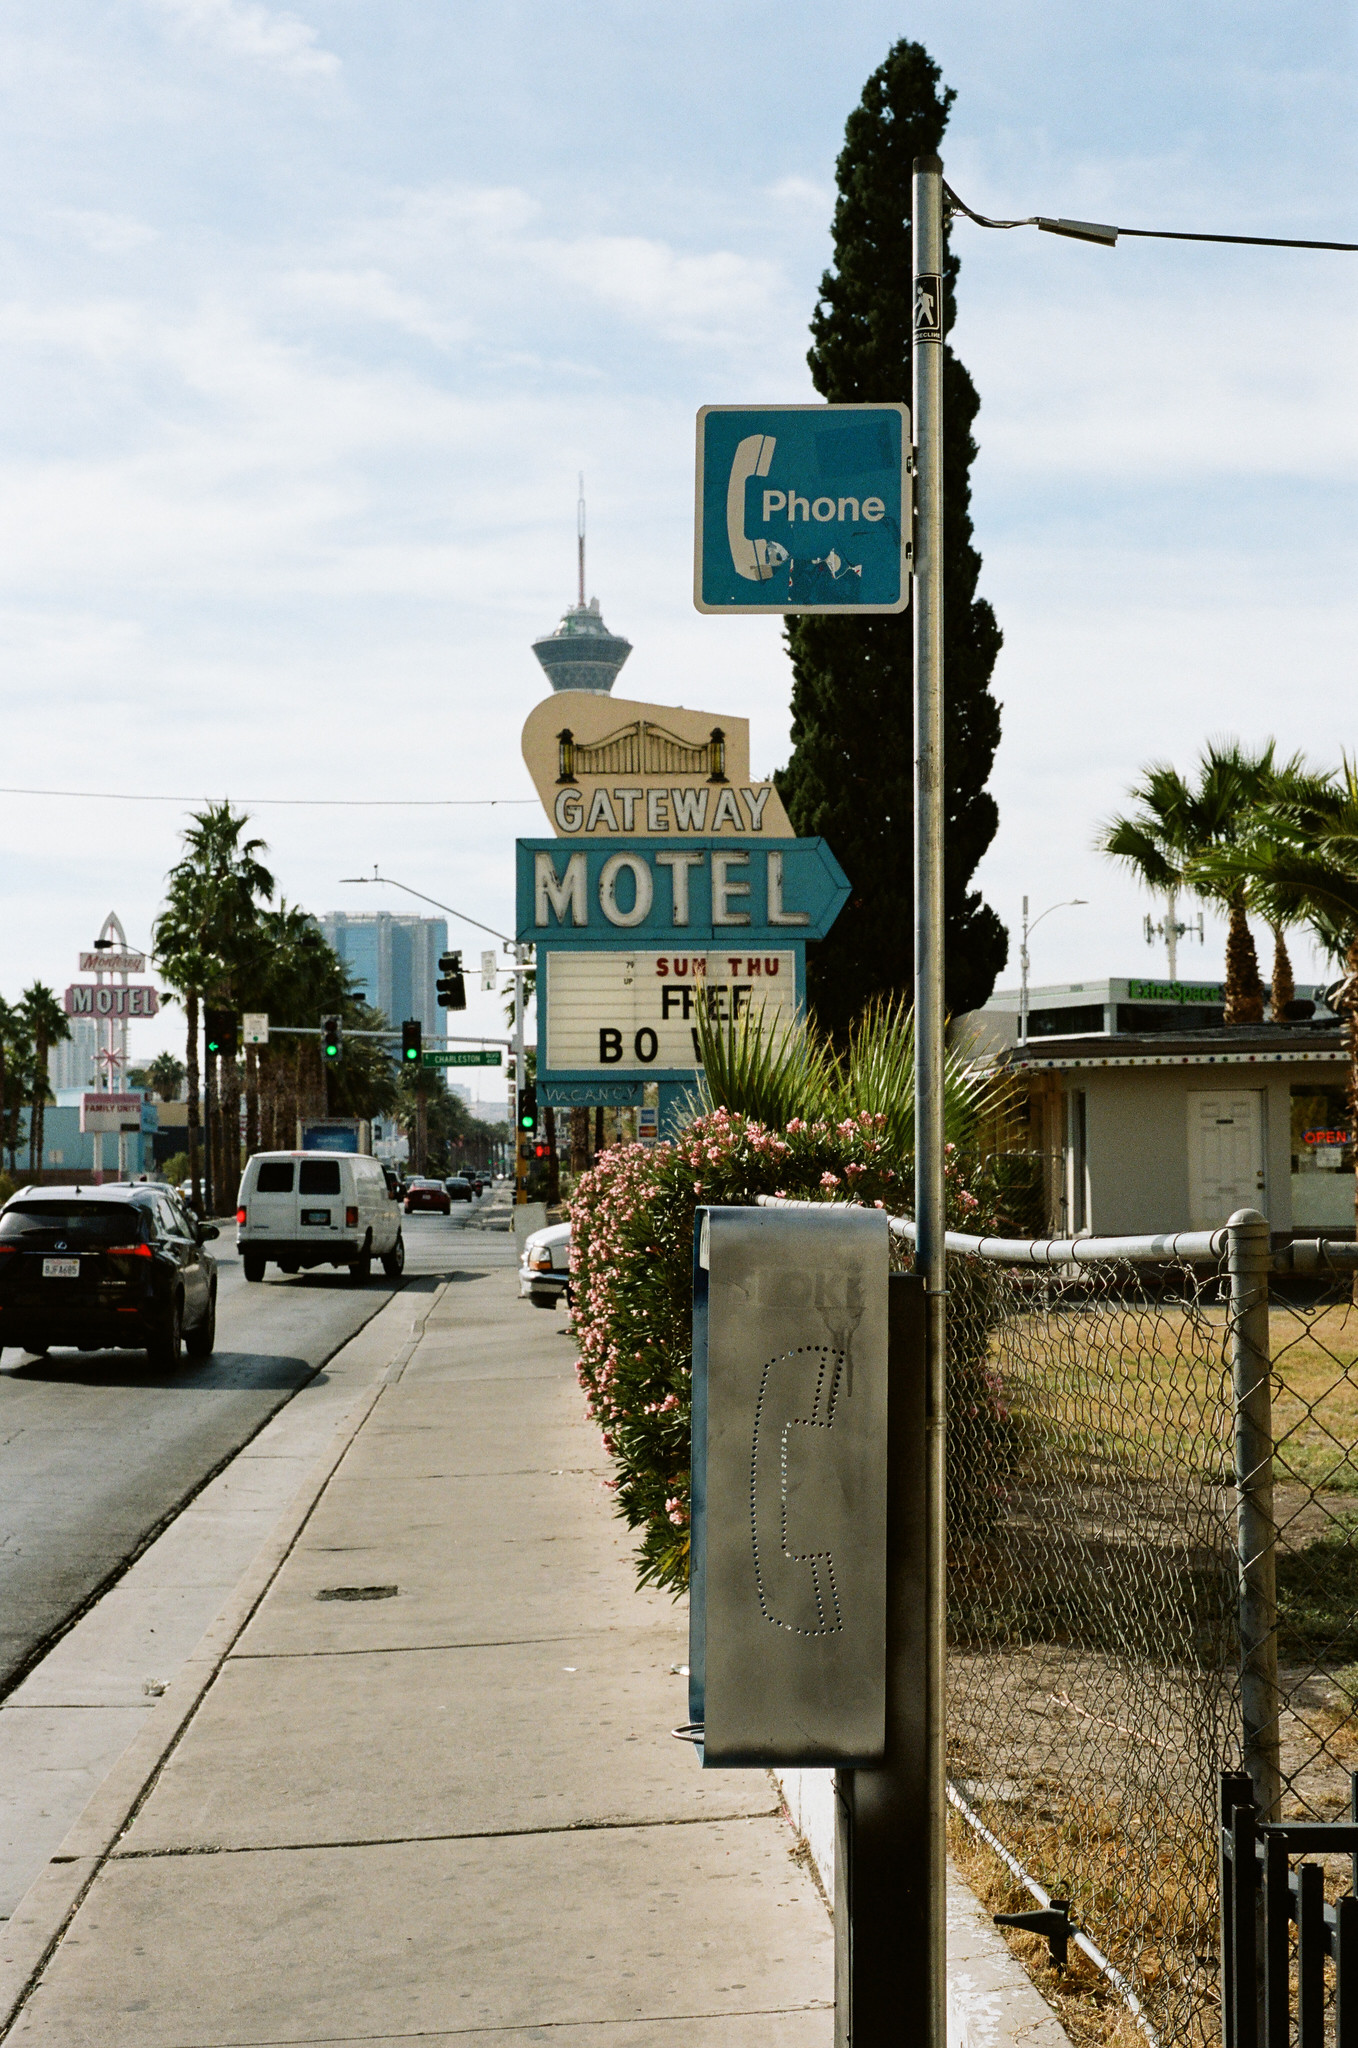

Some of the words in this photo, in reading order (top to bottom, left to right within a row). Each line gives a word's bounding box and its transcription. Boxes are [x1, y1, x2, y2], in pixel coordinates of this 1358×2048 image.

[762, 490, 885, 521] Phone
[555, 788, 771, 832] GATEWAY
[534, 851, 810, 927] MOTEL
[728, 957, 779, 977] THU
[73, 987, 155, 1015] MOTEL
[434, 1055, 480, 1064] CHARLESTON
[546, 1087, 636, 1101] VACANCY
[85, 1104, 114, 1112] FAMILY
[117, 1104, 141, 1112] UNITS
[1304, 1131, 1346, 1144] OPEN
